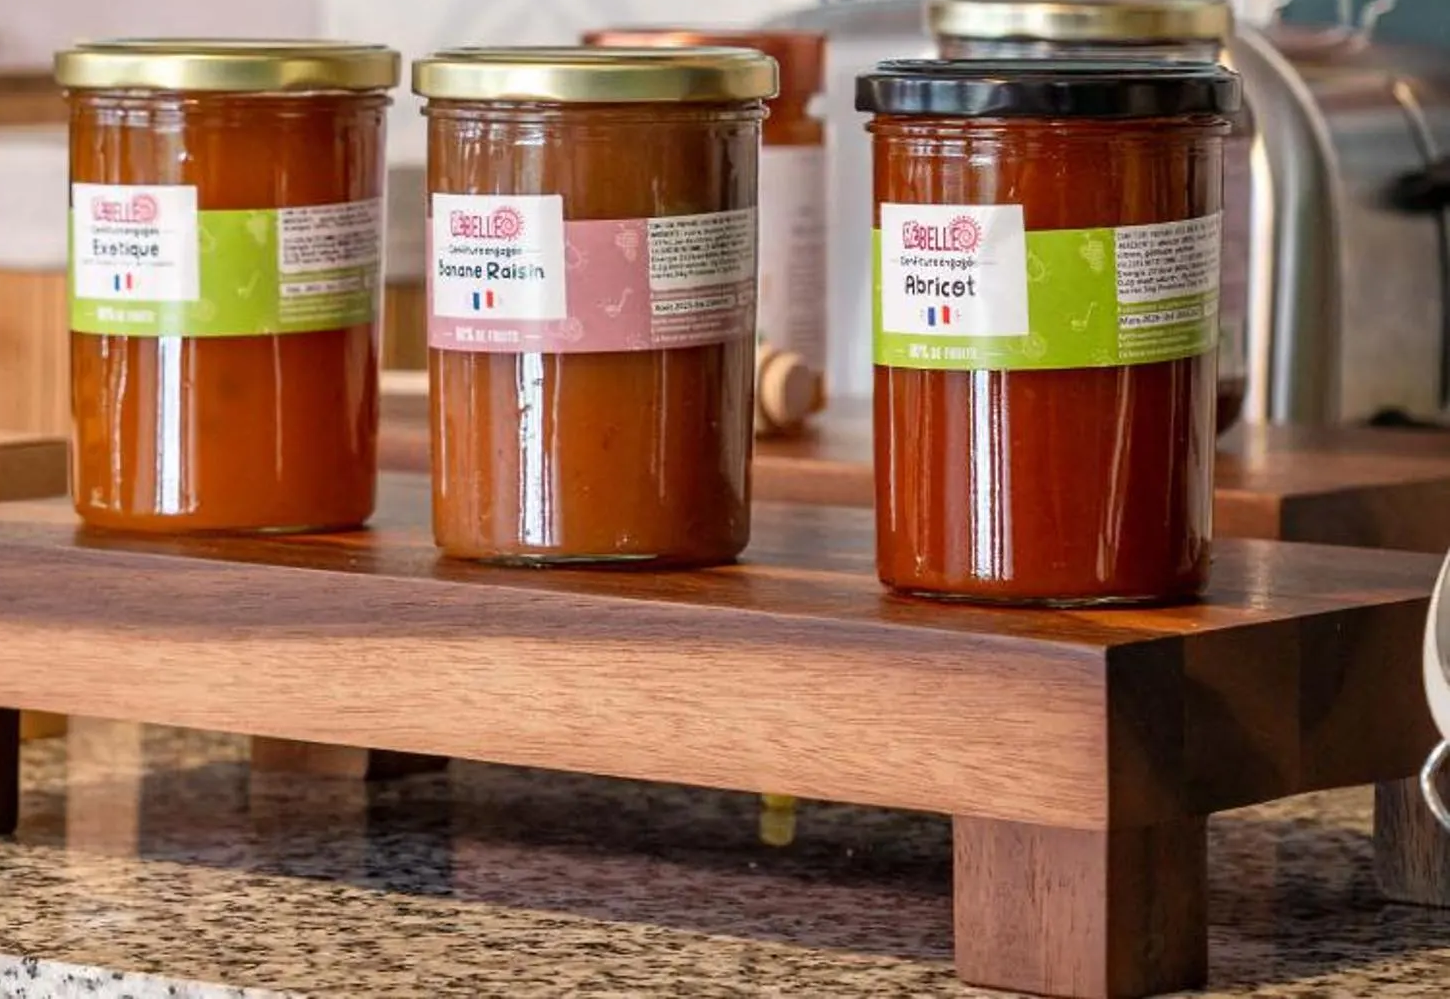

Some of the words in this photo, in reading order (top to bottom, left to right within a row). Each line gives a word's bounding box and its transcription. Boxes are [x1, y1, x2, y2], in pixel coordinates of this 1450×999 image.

[92, 238, 159, 266] Exotique
[486, 261, 546, 280] Raisin
[904, 274, 976, 298] Abricot
